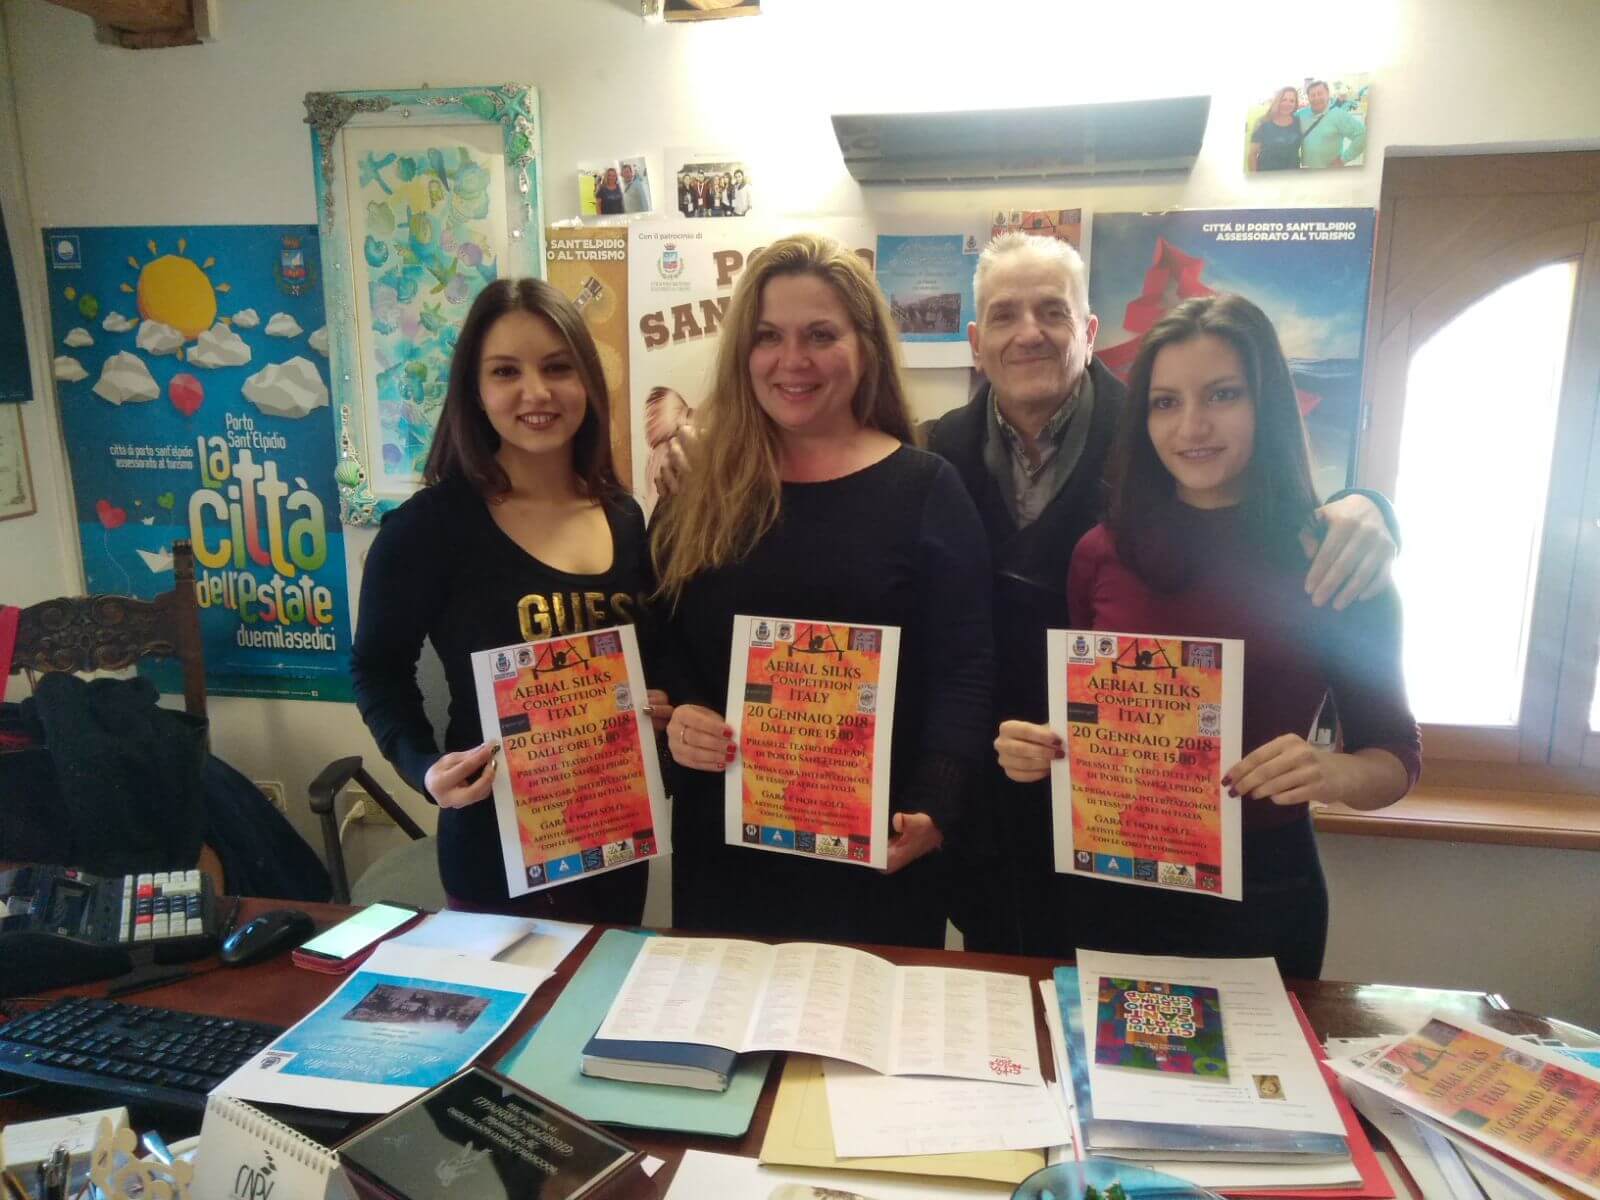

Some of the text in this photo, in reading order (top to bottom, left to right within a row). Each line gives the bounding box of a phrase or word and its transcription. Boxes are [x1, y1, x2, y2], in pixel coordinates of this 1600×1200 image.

[1216, 231, 1356, 241] ASSESSORATO AL TURISMO
[1234, 223, 1246, 232] DI
[1247, 223, 1284, 232] PORTO
[1286, 222, 1357, 232] SANT'ELPIDIO
[557, 250, 574, 261] AL
[575, 250, 626, 261] TURISMO
[225, 412, 254, 431] Porto
[227, 431, 287, 452] Sant'Elpidio
[237, 623, 336, 651] duemilasedici
[765, 659, 861, 678] AERIAL SILKS
[513, 671, 612, 700] AERIAL SILKS
[769, 674, 852, 691] COMPETITION
[1087, 676, 1201, 698] AERIAL SILKS
[522, 687, 607, 711] COMPETITION
[790, 689, 830, 704] ITALY
[1094, 692, 1191, 711] COMPETITION
[548, 703, 588, 721] ITALY
[747, 705, 868, 728] 20 GENNAIO 2018
[1118, 708, 1165, 726] ITALY
[509, 736, 527, 751] 20
[530, 722, 597, 745] GENNAIO
[600, 714, 631, 730] 2018
[760, 722, 797, 734] DALLE
[799, 727, 821, 738] ORE
[1072, 725, 1213, 751] 20 GENNAIO 2018
[527, 746, 564, 761] DALLE
[567, 740, 591, 753] ORE
[767, 751, 797, 761] PORTO
[789, 742, 821, 752] TEATRO
[1089, 743, 1130, 758] DALLE
[1132, 750, 1160, 761] ORE
[561, 755, 593, 768] TEATRO
[1123, 763, 1160, 777] TEATRO
[540, 772, 571, 786] PORTO
[1099, 772, 1133, 784] PORTO
[1094, 814, 1123, 827] GARA
